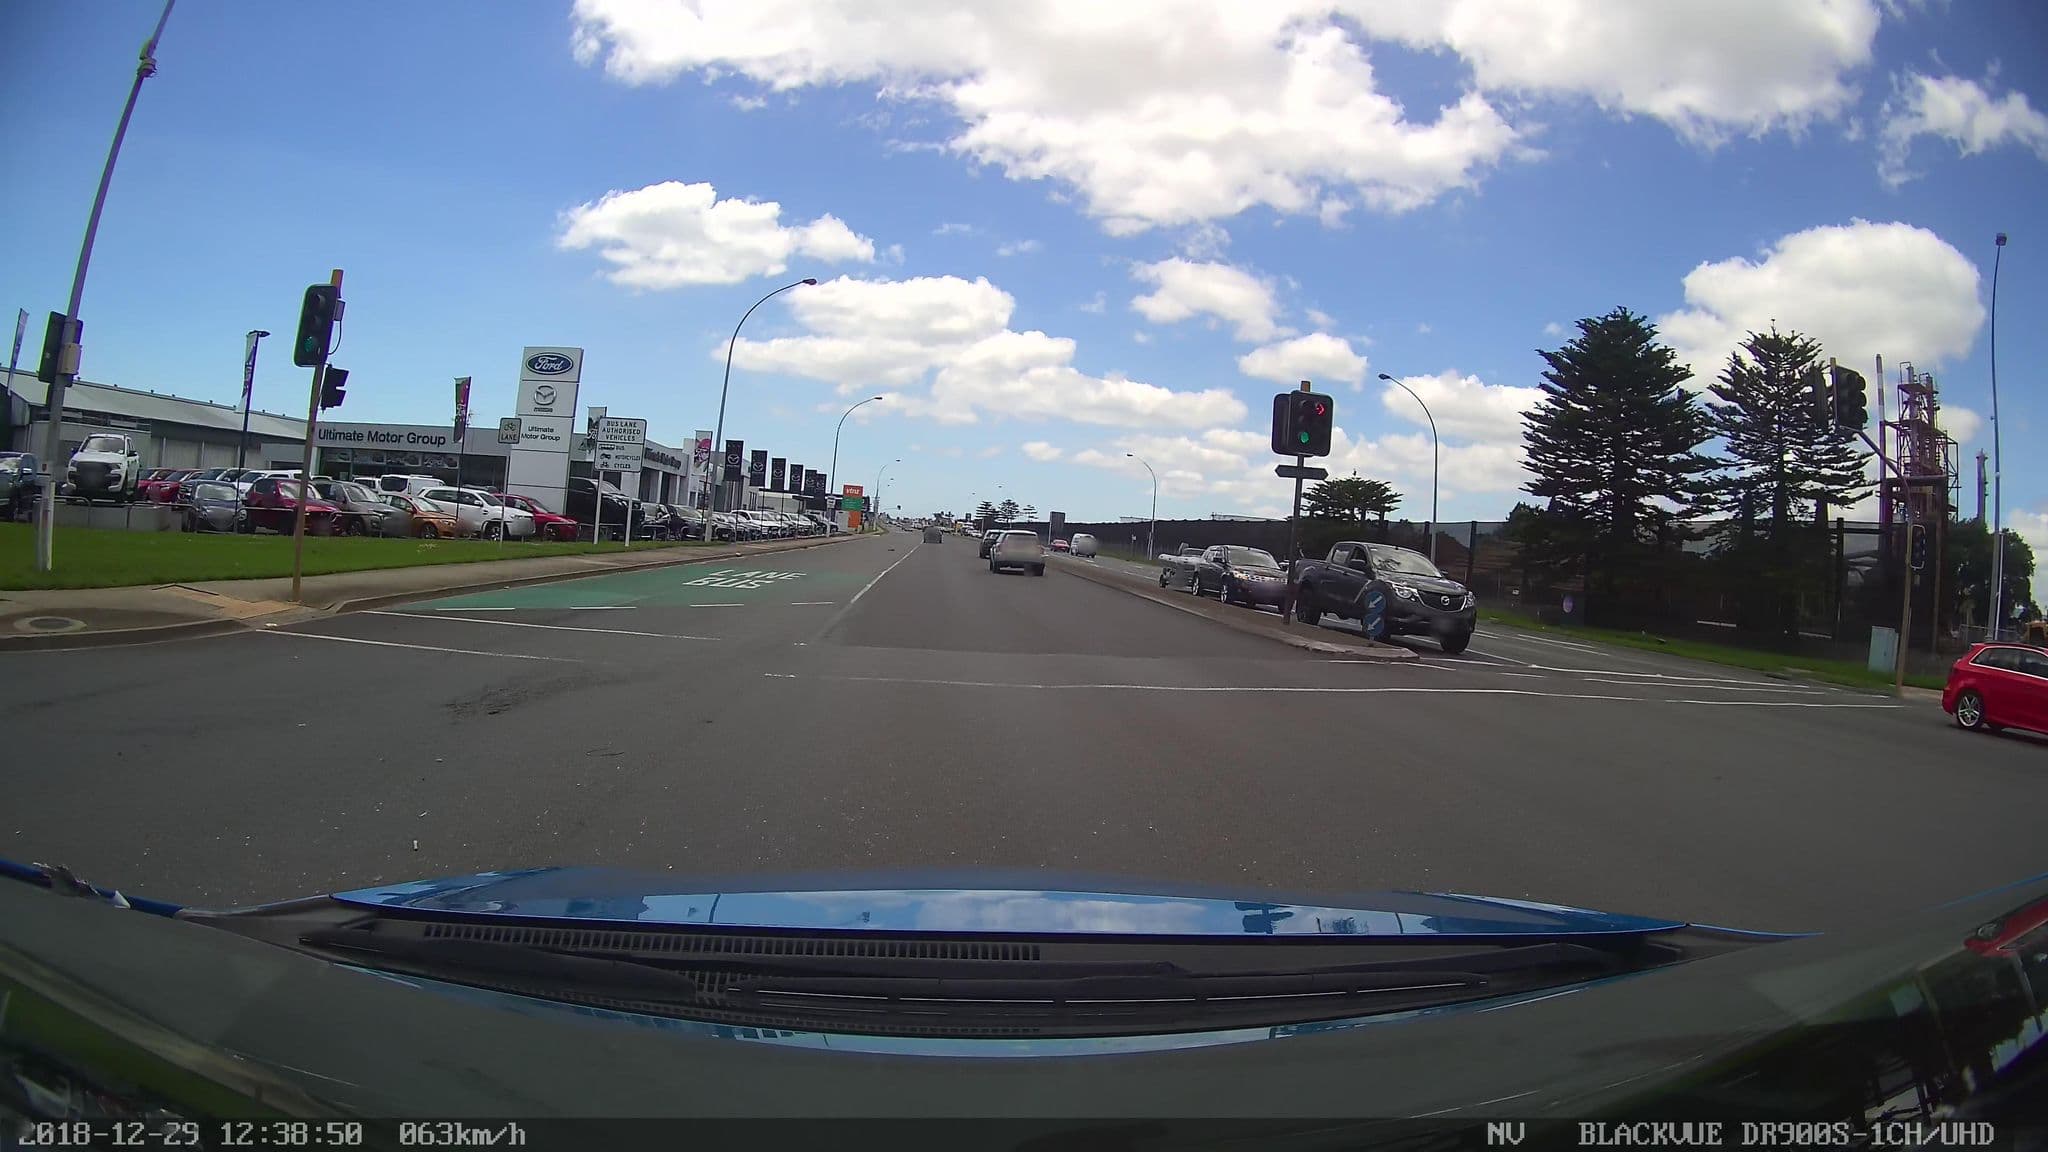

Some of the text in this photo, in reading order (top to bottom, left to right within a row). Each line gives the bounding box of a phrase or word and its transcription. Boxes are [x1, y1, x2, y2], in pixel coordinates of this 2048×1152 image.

[534, 356, 564, 371] Ford
[527, 425, 554, 433] Ultimate
[601, 427, 641, 435] AUTHORISED
[318, 428, 446, 448] Ultimate Motor Group
[520, 433, 561, 442] Motor Group
[605, 434, 636, 442] VEHICLES
[708, 569, 807, 580] LANE
[682, 577, 776, 589] BUS
